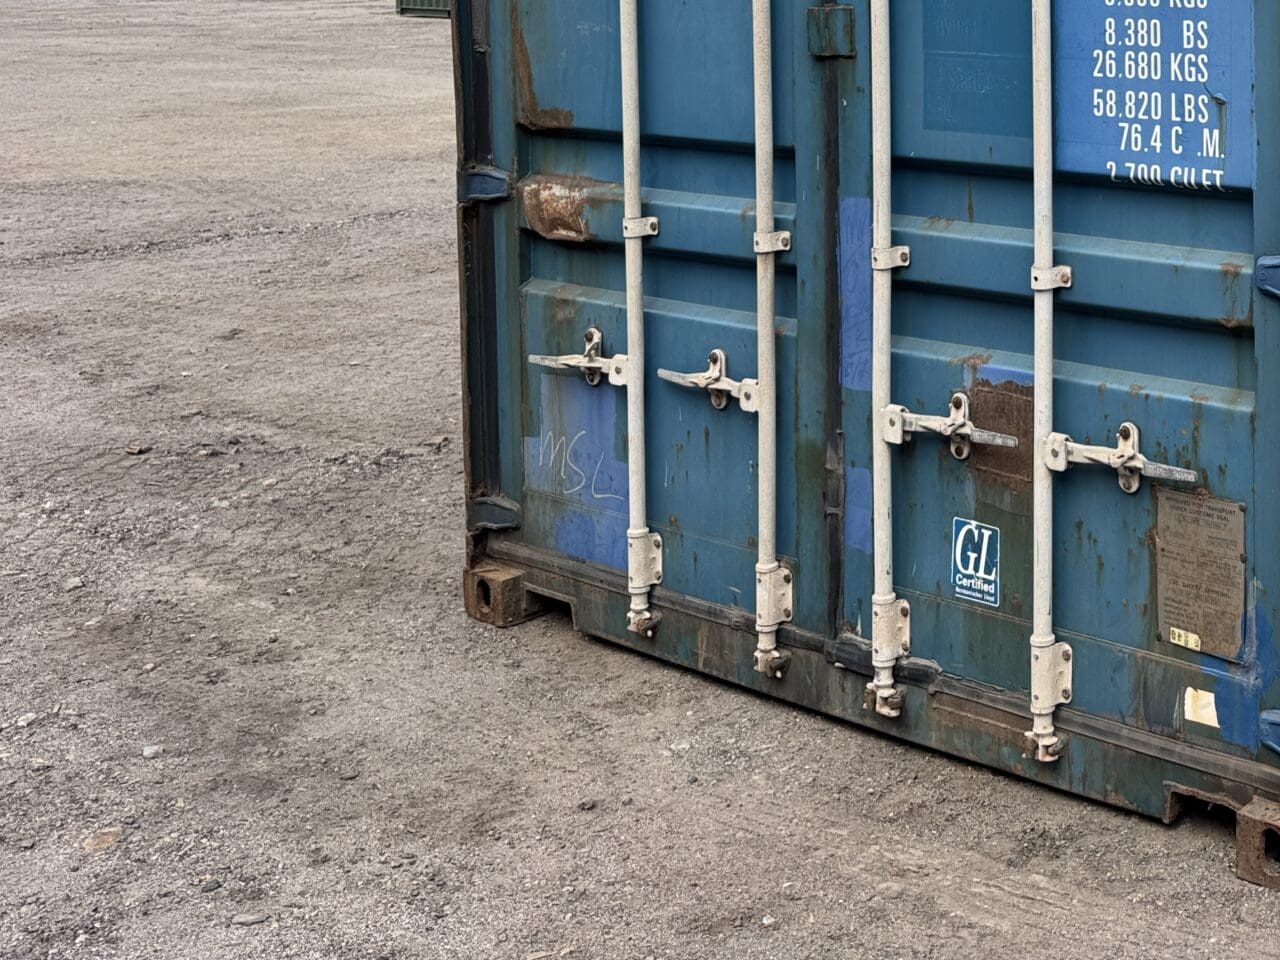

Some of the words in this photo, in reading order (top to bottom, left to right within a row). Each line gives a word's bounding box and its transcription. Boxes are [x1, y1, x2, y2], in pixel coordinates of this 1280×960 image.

[1182, 20, 1208, 49] BS
[1170, 53, 1209, 83] KGS
[1171, 93, 1209, 123] LBS
[1118, 122, 1162, 153] 76.4
[955, 524, 996, 580] GL
[955, 573, 995, 593] Certified
